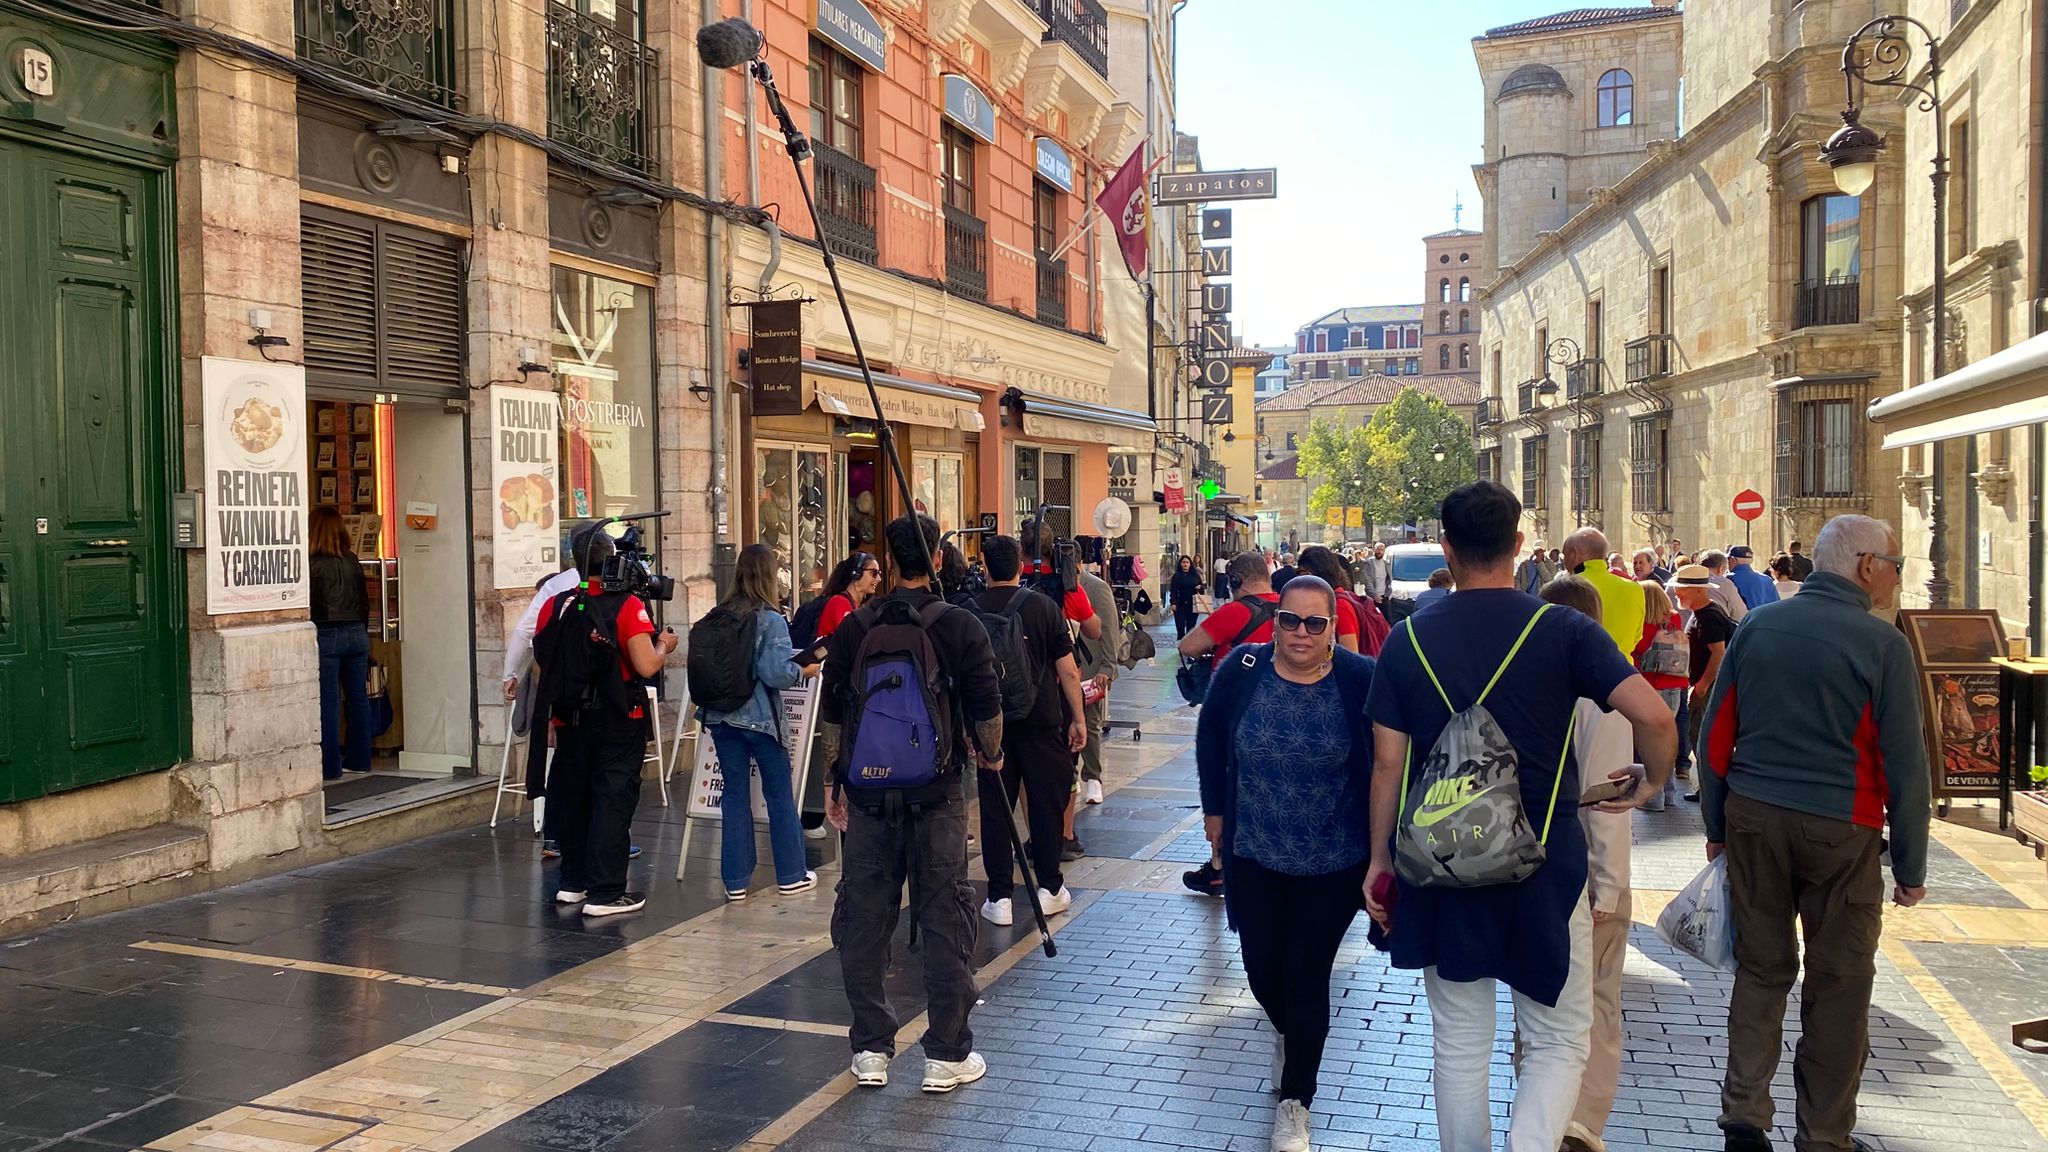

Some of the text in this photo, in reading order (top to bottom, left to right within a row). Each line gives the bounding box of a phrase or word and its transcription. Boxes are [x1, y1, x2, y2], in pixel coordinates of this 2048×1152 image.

[850, 19, 884, 58] MERCANTILES
[27, 58, 48, 82] 15
[1037, 147, 1072, 186] COLEGIO OFICIAL
[1170, 176, 1265, 194] zapatos
[754, 328, 798, 338] Sombrerería
[1204, 248, 1230, 421] MUÑOZ
[755, 355, 800, 364] Beatriz Mielgo
[763, 383, 792, 392] Hat shop
[499, 398, 552, 431] ITALIAN
[500, 430, 550, 464] ROLL
[217, 470, 300, 507] REINETA
[218, 510, 301, 547] VAINILLA
[220, 548, 301, 587] Y CARAMELO
[1424, 774, 1476, 806] NIKE
[1947, 777, 1959, 785] DE
[1961, 777, 1990, 786] VENTA
[1427, 824, 1484, 845] AIR
